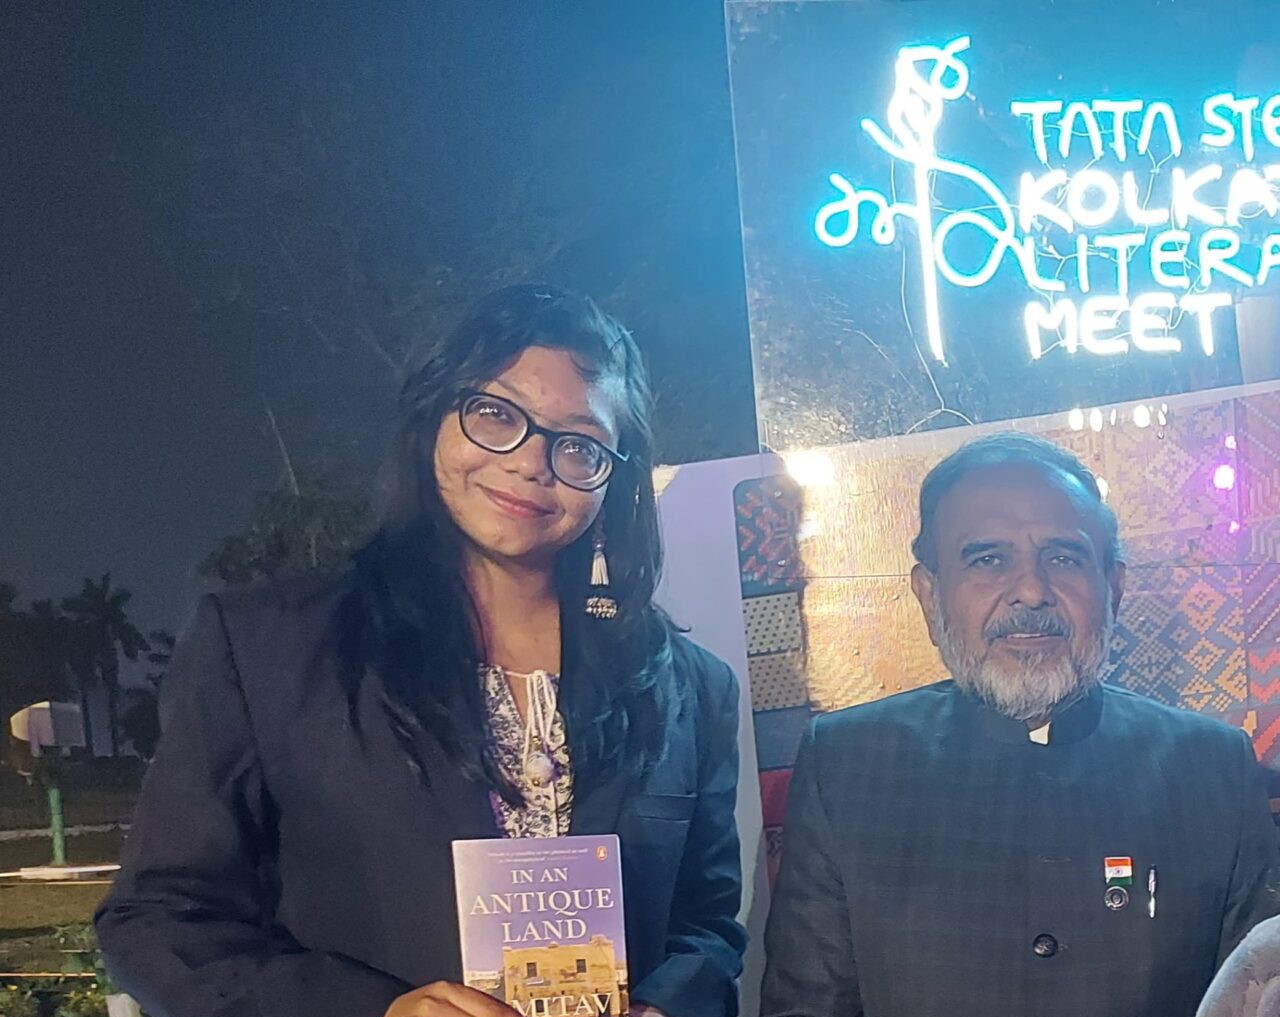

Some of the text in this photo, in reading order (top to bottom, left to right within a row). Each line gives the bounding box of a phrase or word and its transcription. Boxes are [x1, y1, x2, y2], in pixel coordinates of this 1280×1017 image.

[1011, 100, 1181, 161] TATA
[1023, 293, 1233, 360] MEET
[511, 867, 568, 884] IN AN
[470, 888, 614, 917] ANTIQUE
[502, 919, 587, 943] LAND
